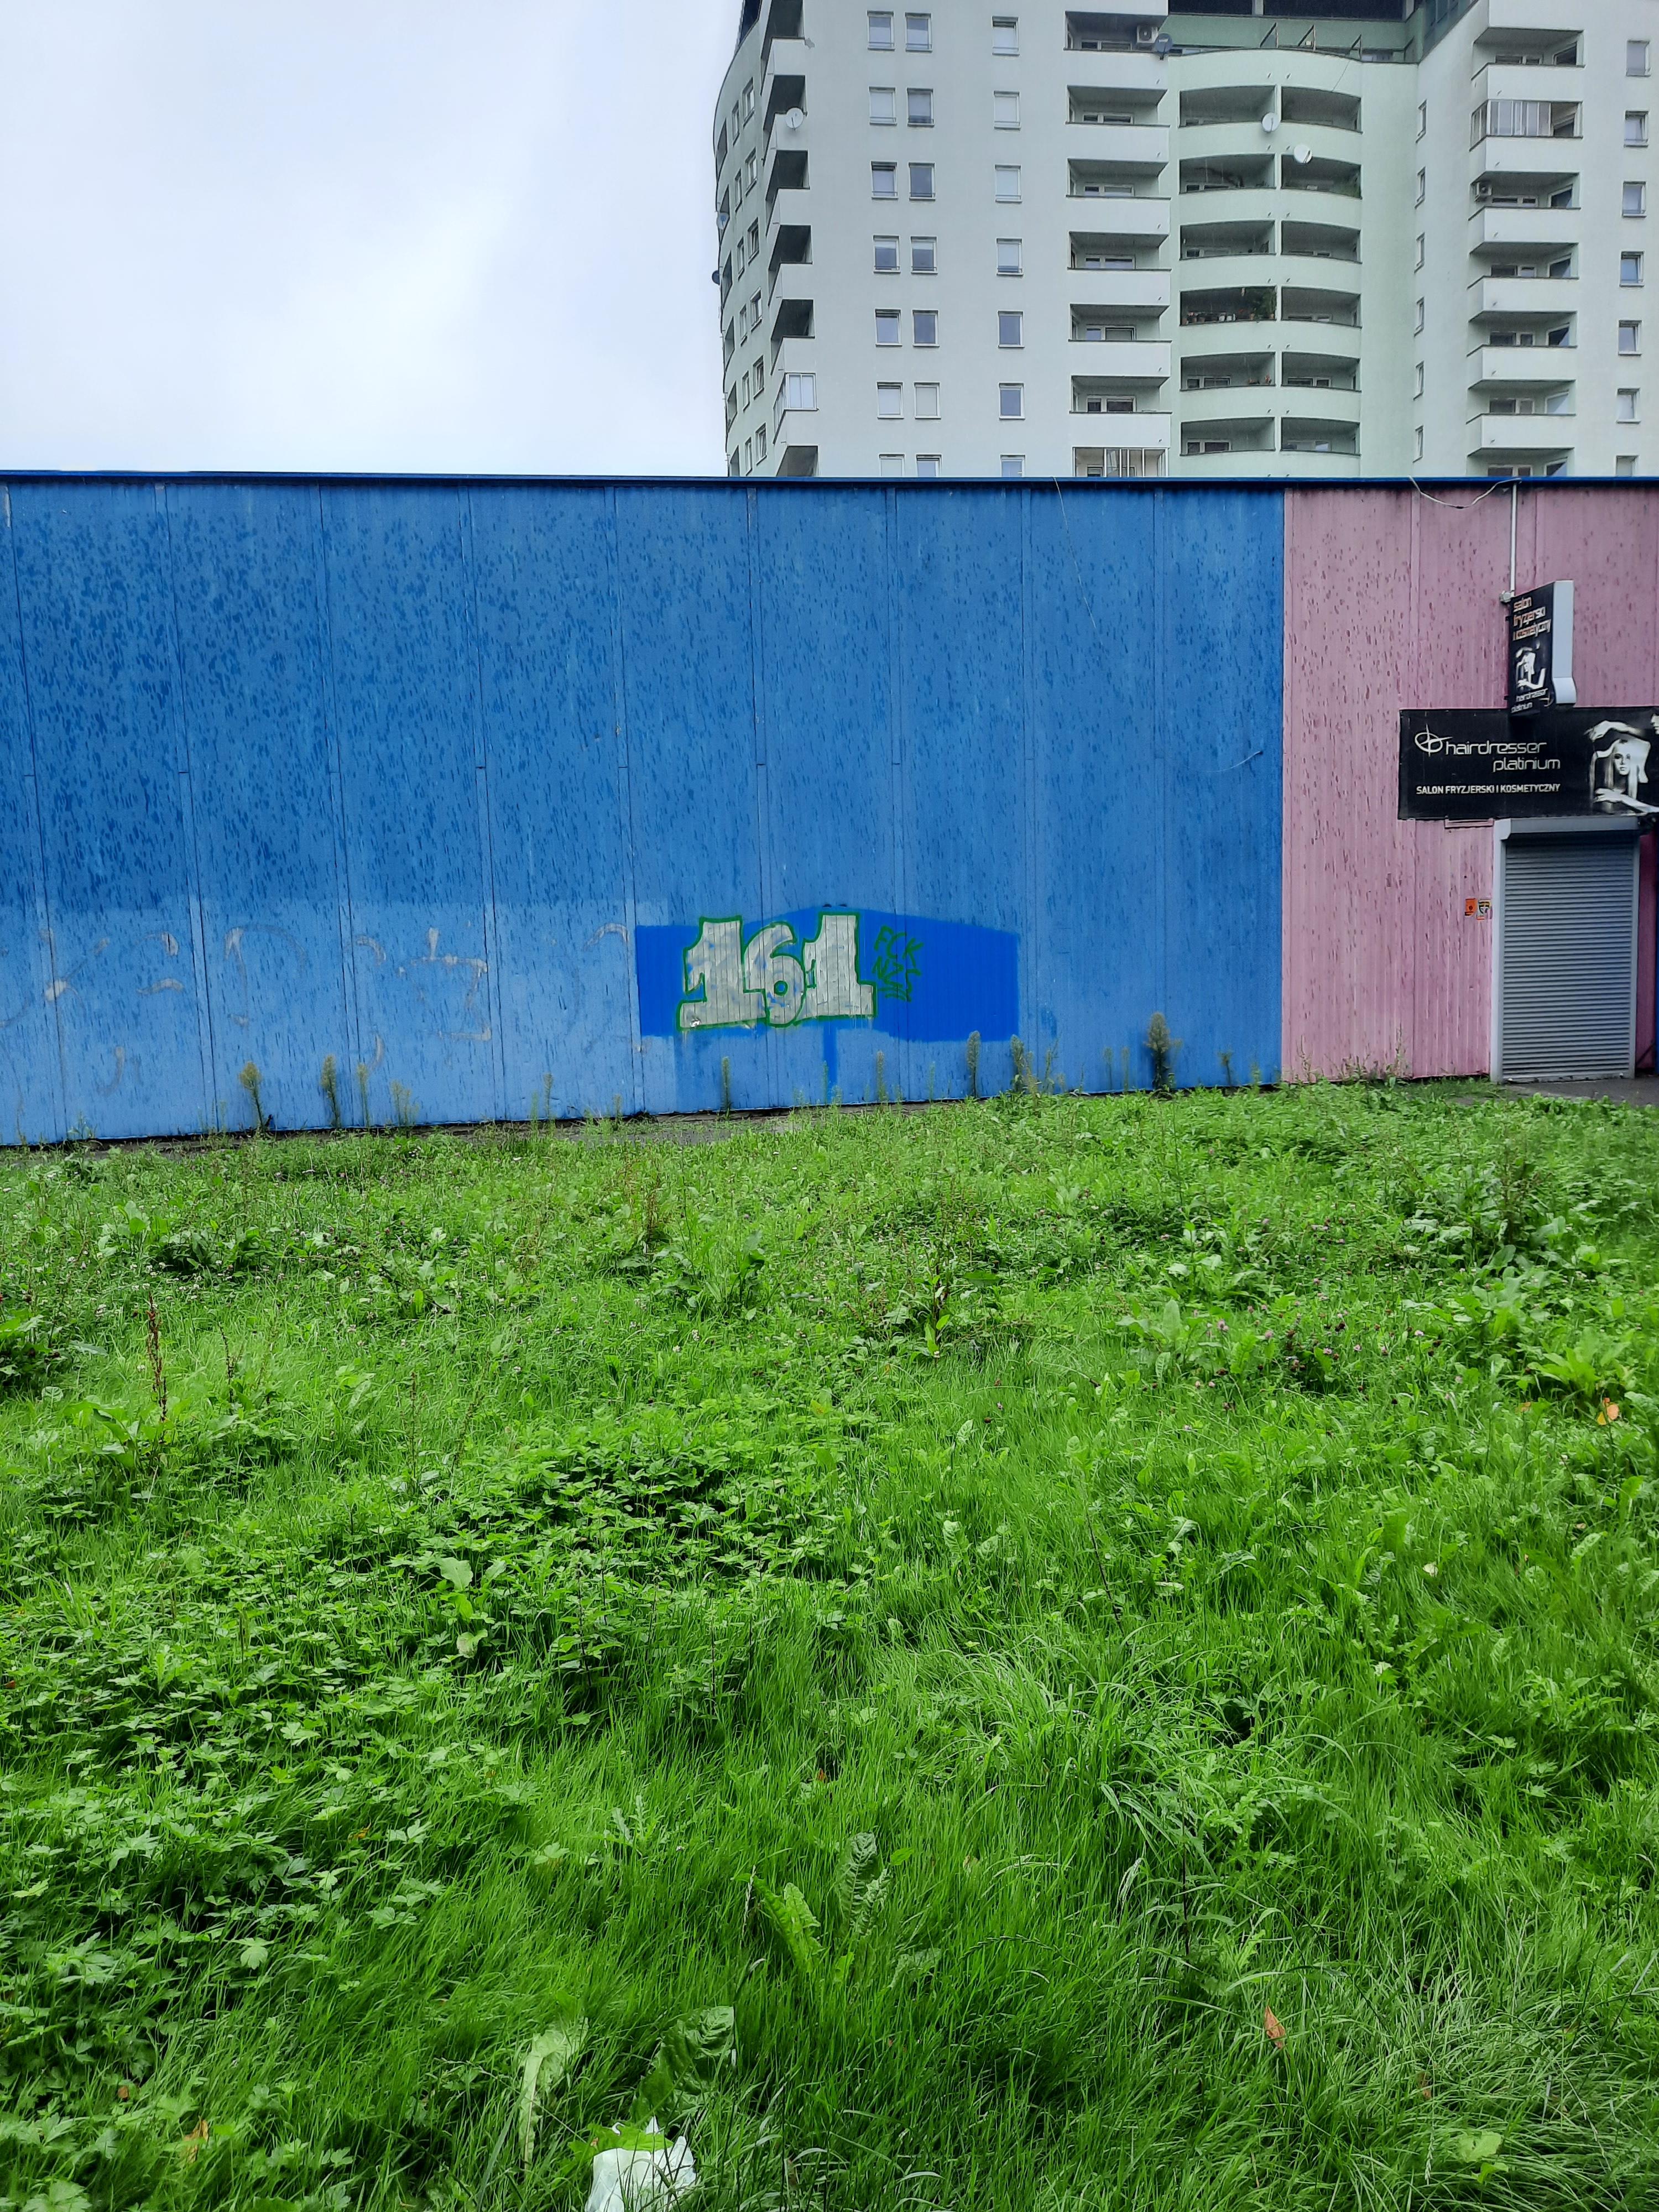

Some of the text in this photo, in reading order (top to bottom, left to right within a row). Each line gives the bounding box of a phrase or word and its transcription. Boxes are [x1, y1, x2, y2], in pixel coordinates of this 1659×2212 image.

[1513, 597, 1532, 613] salon
[1446, 740, 1547, 755] hairdresser
[1493, 757, 1561, 773] platinium
[1416, 786, 1444, 794] SALON
[1445, 785, 1495, 794] FRYZJERSKI
[1500, 784, 1561, 792] KOSMETYCZNY
[873, 924, 925, 969] FCK
[677, 911, 877, 1030] 161
